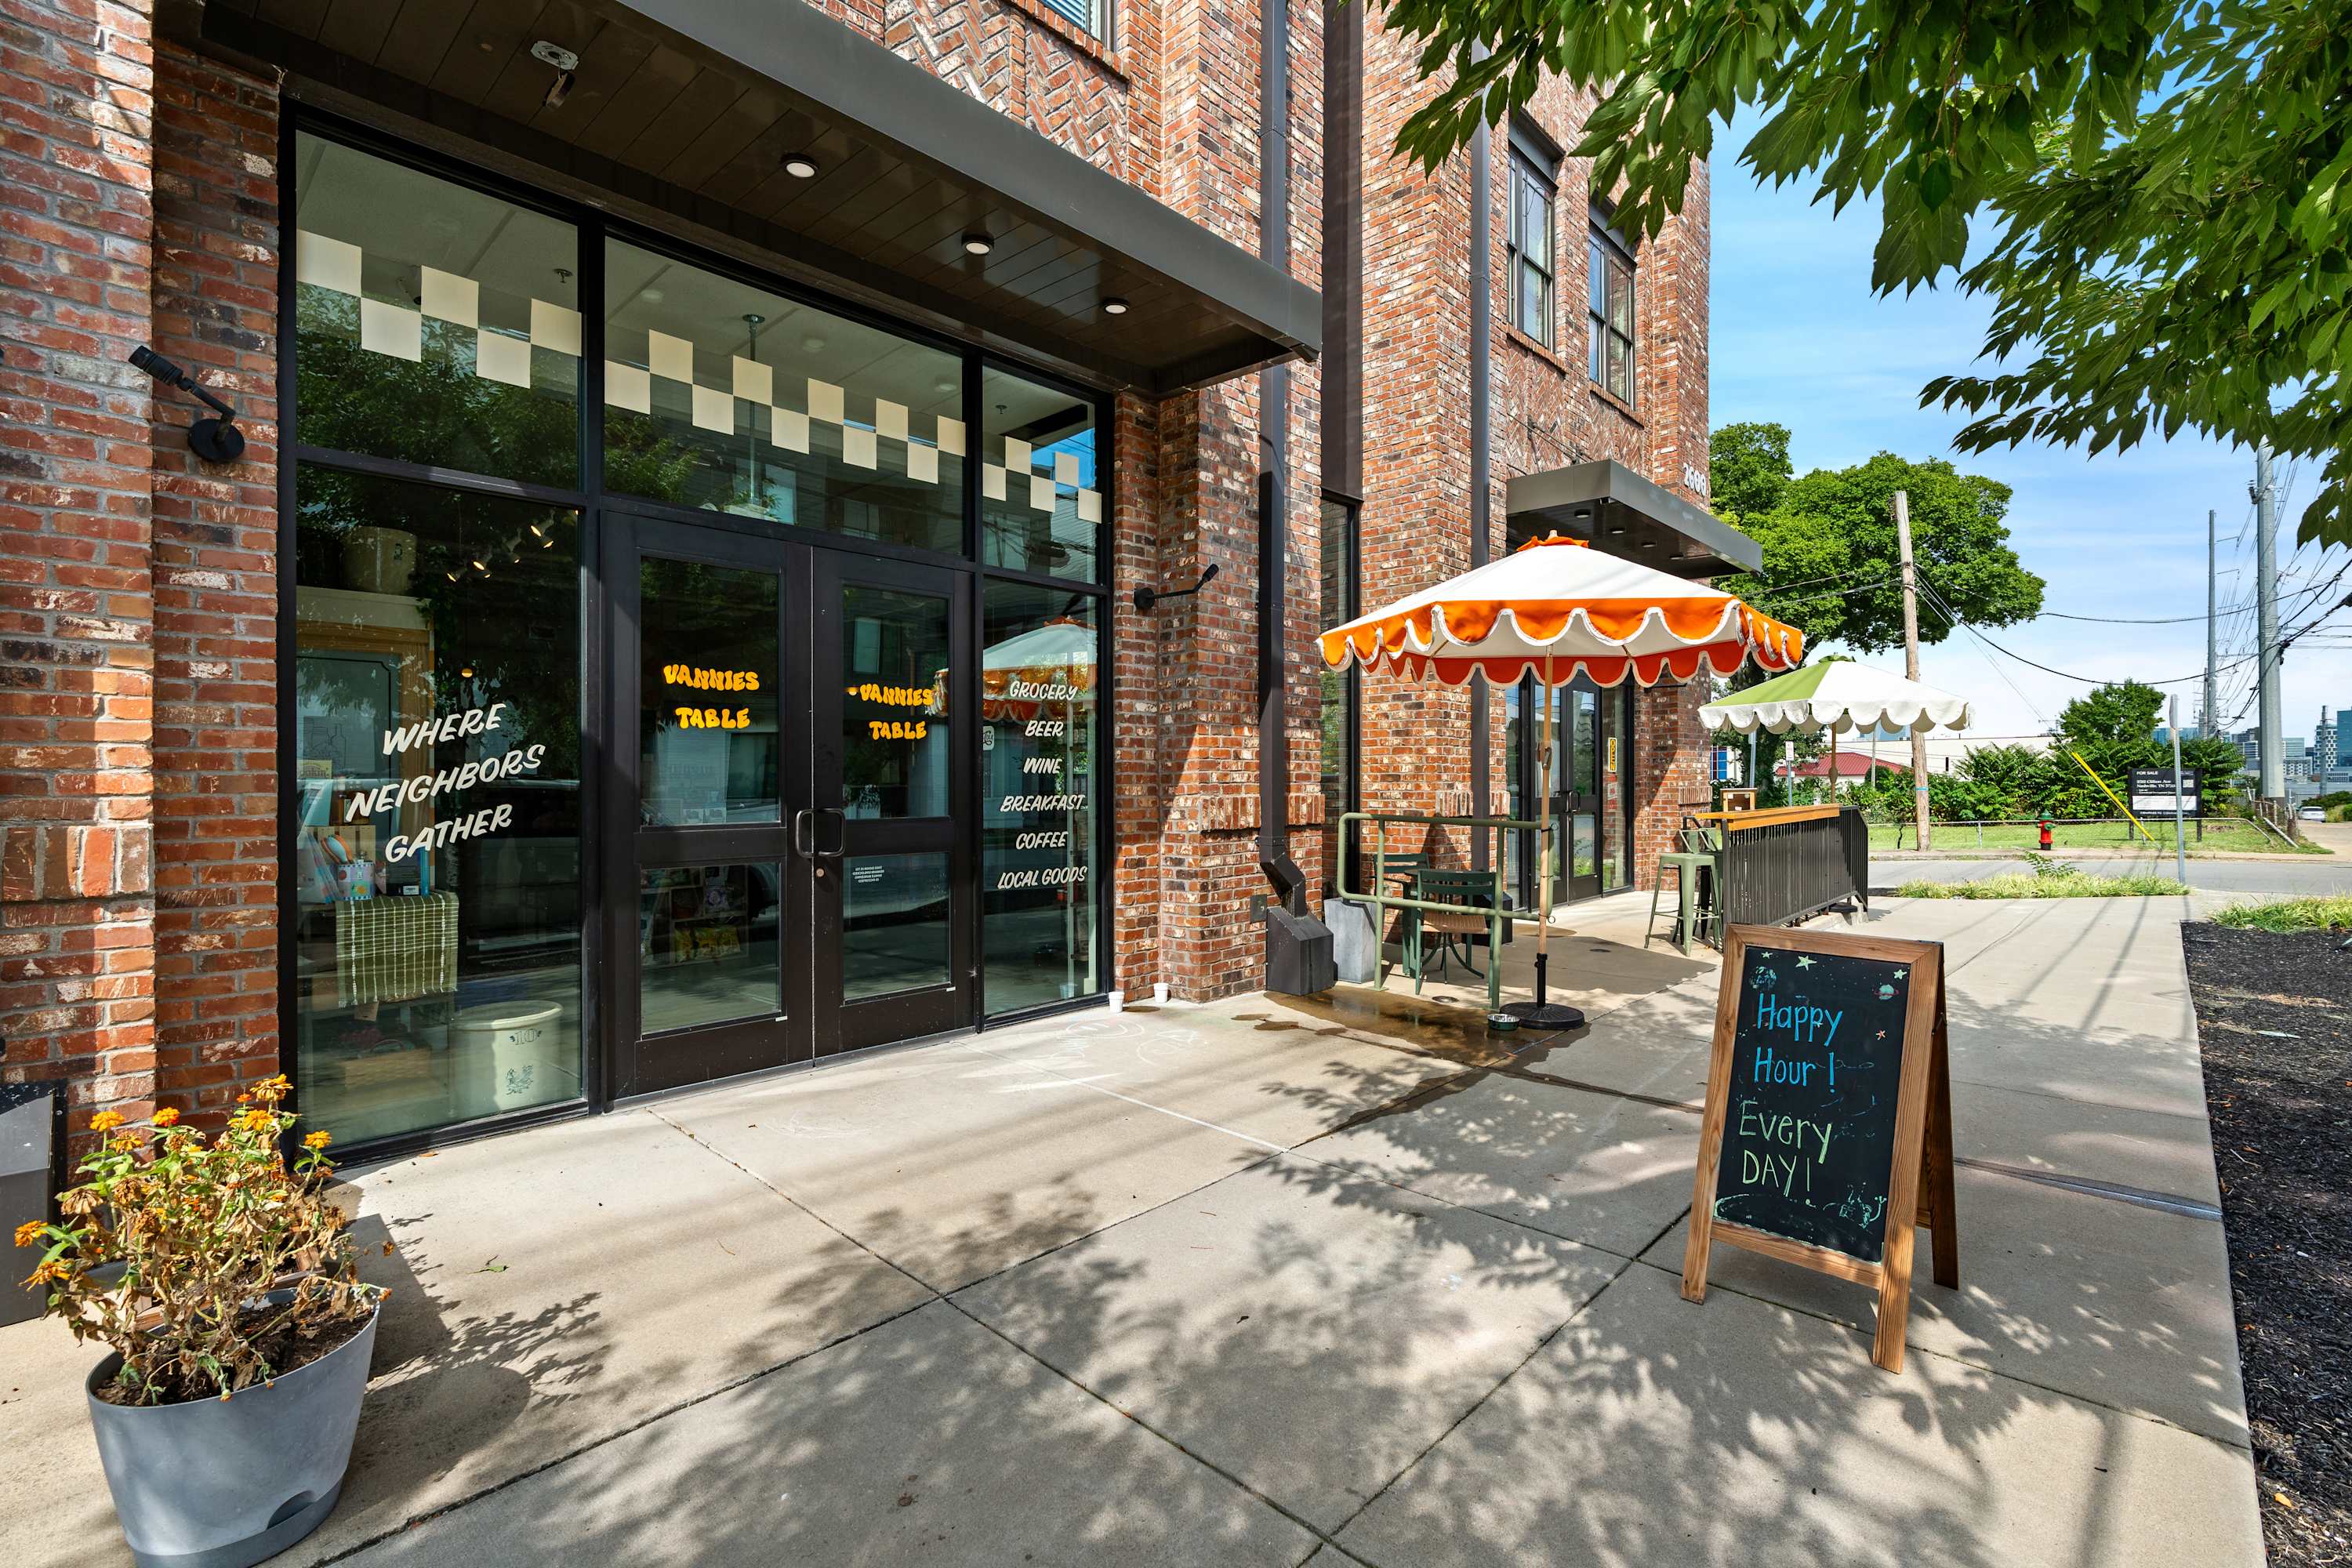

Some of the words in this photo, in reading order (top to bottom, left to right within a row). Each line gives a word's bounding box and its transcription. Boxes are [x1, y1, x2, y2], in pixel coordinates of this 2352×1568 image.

[662, 664, 760, 691] VANNIES
[859, 683, 934, 706] VANNIES
[1009, 681, 1079, 701] GROCERY
[675, 706, 750, 729] TABLE
[1025, 720, 1064, 737] BEER
[383, 703, 506, 756] WHERE
[869, 720, 927, 741] TABLE
[1022, 757, 1063, 775] WINE
[345, 744, 546, 823] NEIGHBORS
[1000, 794, 1086, 812] BREAKFAST
[385, 804, 513, 862] GATHER
[1015, 831, 1069, 850] COFFEE
[997, 869, 1040, 890] LOCAL
[1041, 866, 1088, 885] GOODS
[1757, 993, 1843, 1047] Happy
[1739, 1099, 1832, 1165] Every
[1742, 1149, 1812, 1205] DAY!
